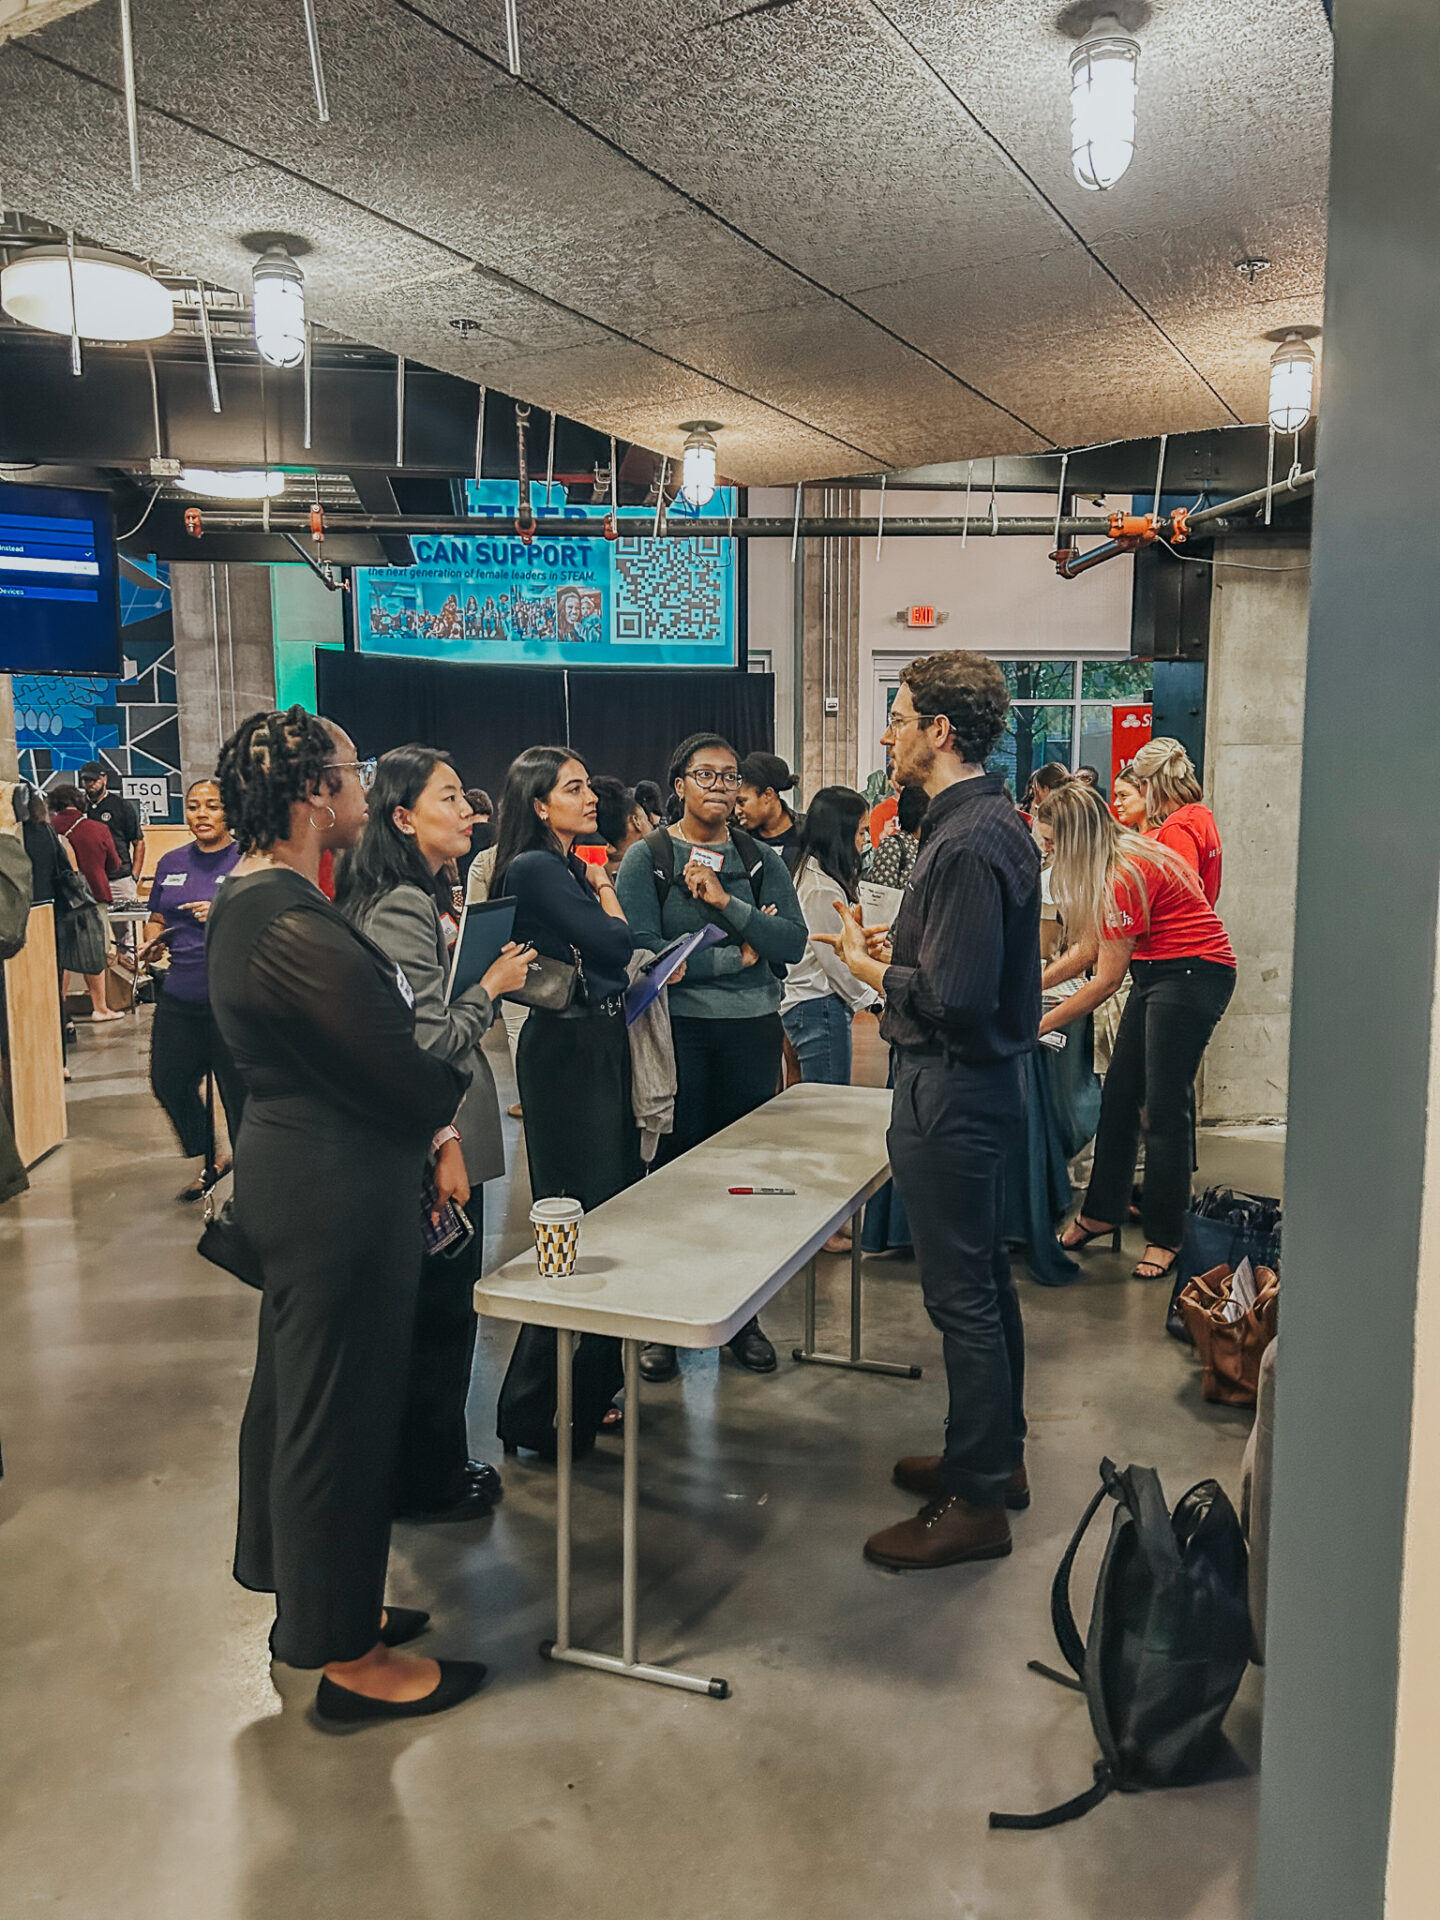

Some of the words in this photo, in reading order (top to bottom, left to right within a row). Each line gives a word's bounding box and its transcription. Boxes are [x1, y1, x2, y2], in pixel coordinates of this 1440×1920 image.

[416, 541, 469, 564] CAN
[475, 542, 592, 567] SUPPORT
[368, 567, 384, 576] the
[386, 567, 407, 577] next
[409, 567, 462, 579] generation
[464, 568, 475, 578] of
[475, 569, 509, 579] female
[511, 569, 547, 580] leaders
[549, 570, 558, 580] in
[911, 607, 934, 624] EXIT
[127, 783, 162, 797] TSQ
